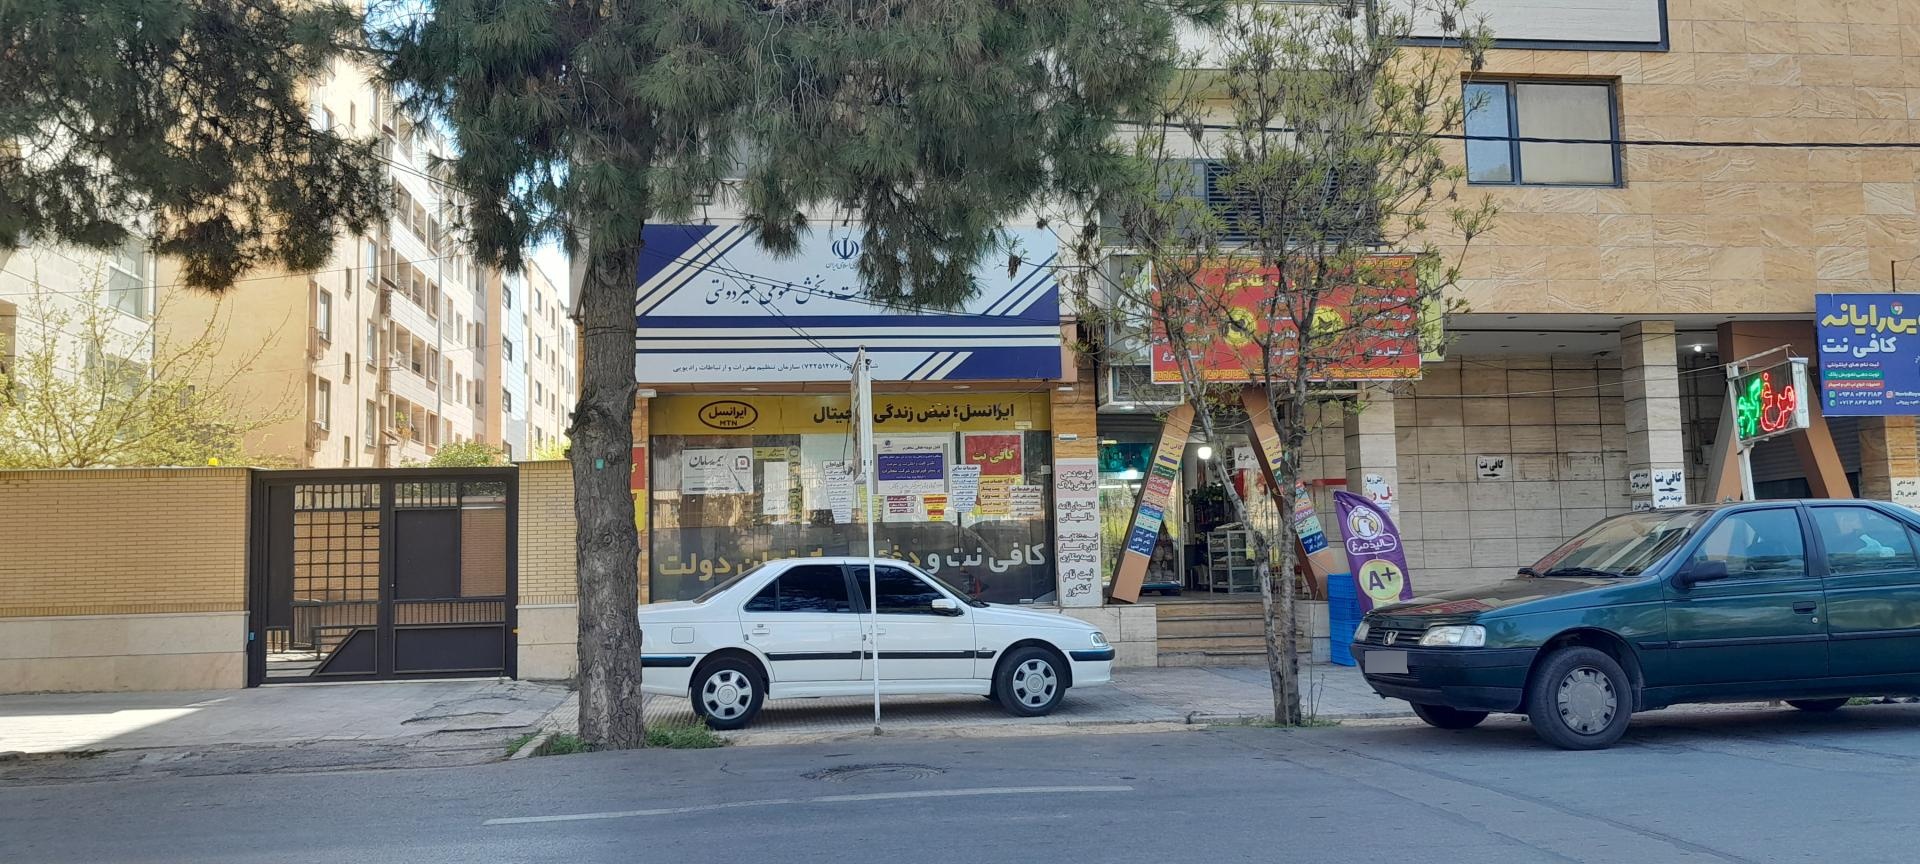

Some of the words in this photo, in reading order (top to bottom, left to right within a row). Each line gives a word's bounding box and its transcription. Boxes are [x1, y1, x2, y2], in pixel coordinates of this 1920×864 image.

[1821, 303, 1887, 335] رایانه
[1822, 337, 1848, 353] نت
[1852, 333, 1896, 358] کافی
[699, 365, 726, 373] ارتباطات
[732, 366, 756, 374] مقررات
[756, 364, 776, 372] تنظیم
[777, 364, 800, 373] سازمان
[1760, 372, 1795, 432] مرغ
[708, 406, 746, 419] ایرانسل
[874, 404, 913, 422] زندگی
[917, 405, 950, 422] نبض
[972, 450, 986, 461] نت
[990, 448, 1014, 464] کافی
[1479, 458, 1488, 469] نت
[1490, 458, 1504, 472] کافی
[1077, 469, 1093, 480] نوبت
[1654, 472, 1664, 482] نت
[1666, 470, 1682, 486] کافی
[1057, 480, 1074, 491] پلاک
[1073, 480, 1096, 491] تعویض
[1058, 512, 1095, 524] مالیاتی
[926, 552, 940, 574] و
[946, 547, 982, 566] نت
[988, 542, 1046, 573] کافی
[659, 552, 732, 580] دولت
[1063, 568, 1076, 582] نام
[1077, 568, 1094, 582] ثبت
[1369, 567, 1396, 590] A+
[1066, 584, 1092, 597] کنکور
